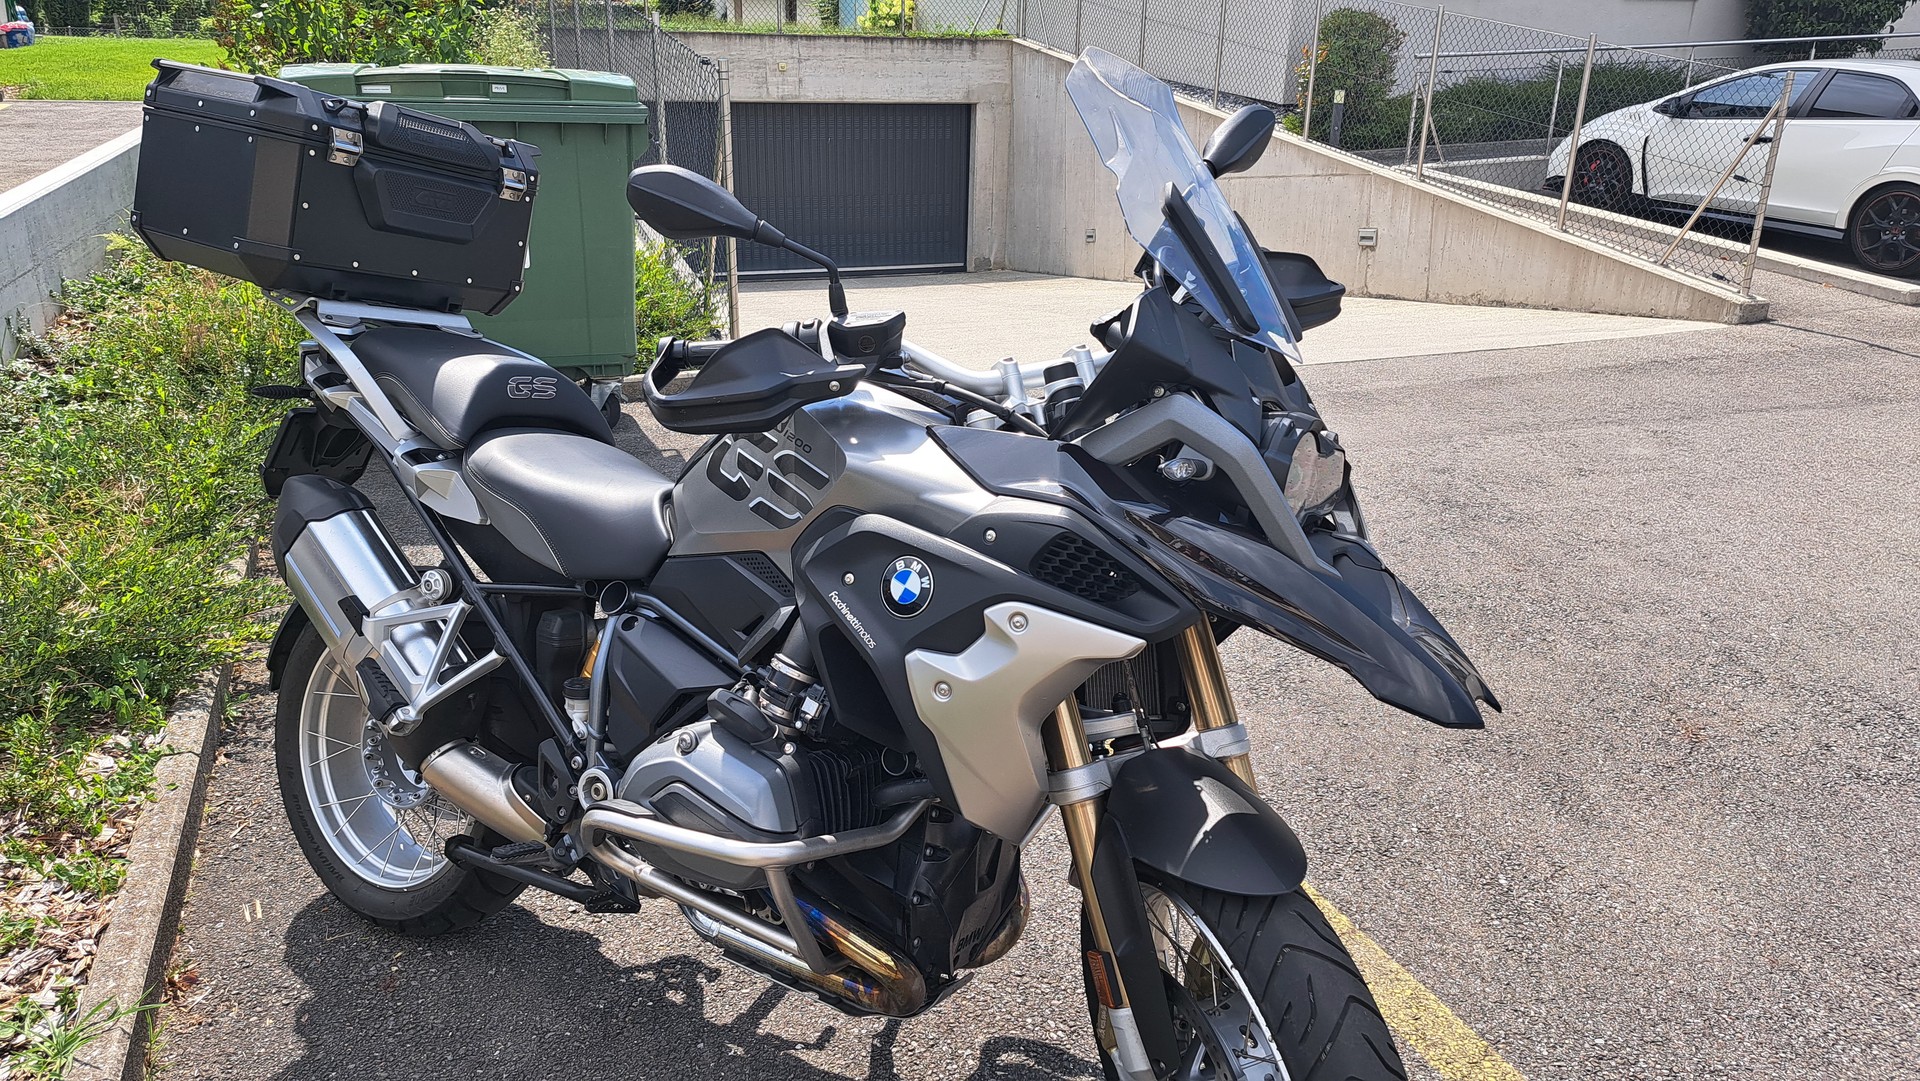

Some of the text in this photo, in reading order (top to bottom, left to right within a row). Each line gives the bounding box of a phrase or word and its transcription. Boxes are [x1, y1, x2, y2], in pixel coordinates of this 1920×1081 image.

[507, 376, 558, 399] GS
[783, 430, 813, 454] 1200
[895, 560, 931, 589] BMW
